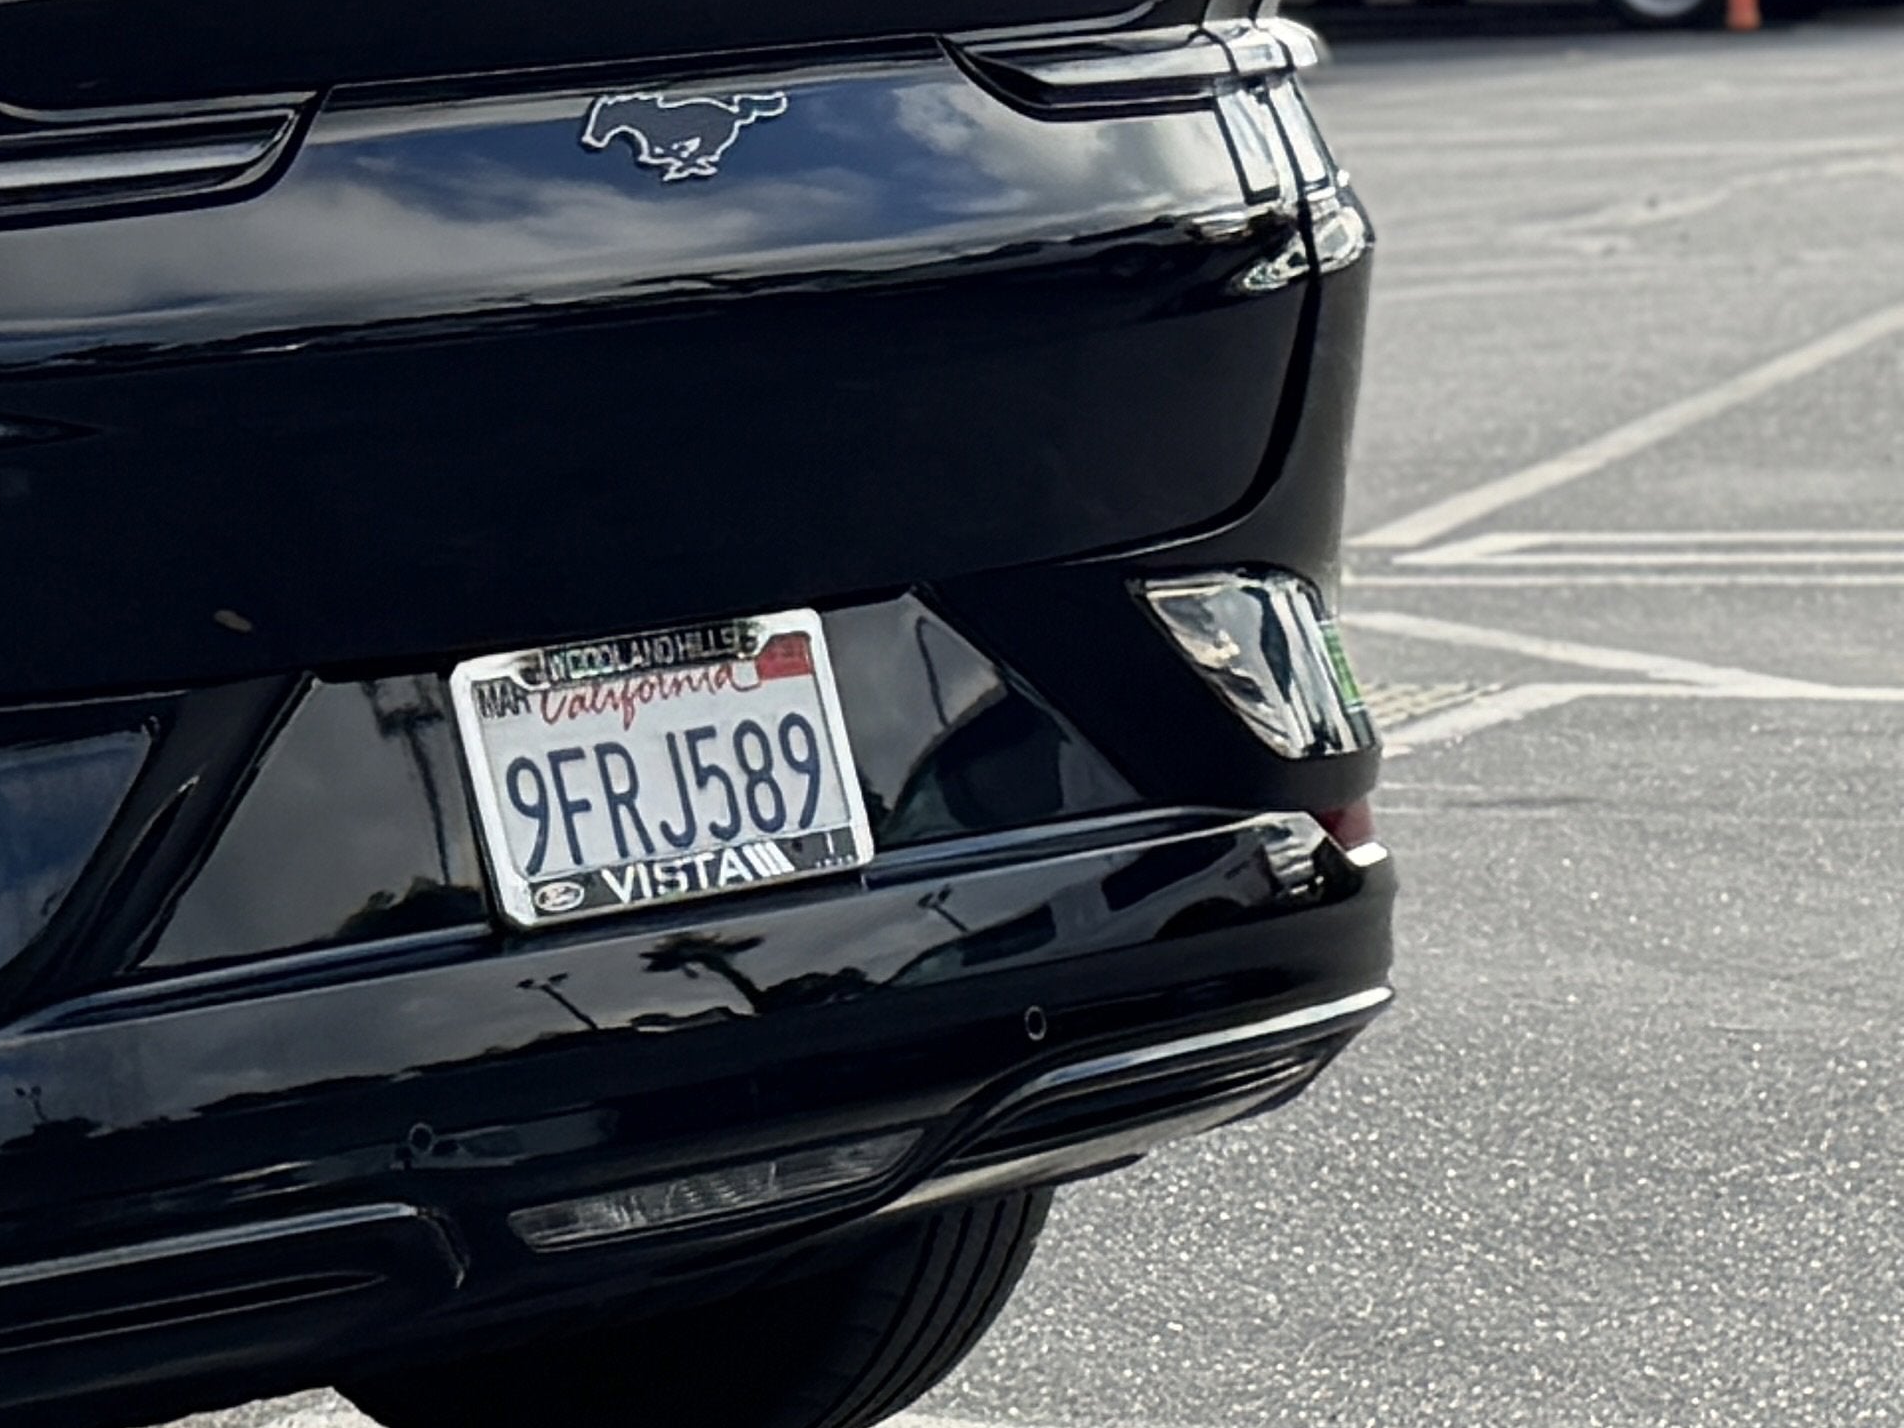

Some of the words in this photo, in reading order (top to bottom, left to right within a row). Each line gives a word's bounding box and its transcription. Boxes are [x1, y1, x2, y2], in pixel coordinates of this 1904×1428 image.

[540, 661, 735, 730] California
[505, 712, 821, 876] 9FRJ589
[600, 847, 753, 905] VISTA
